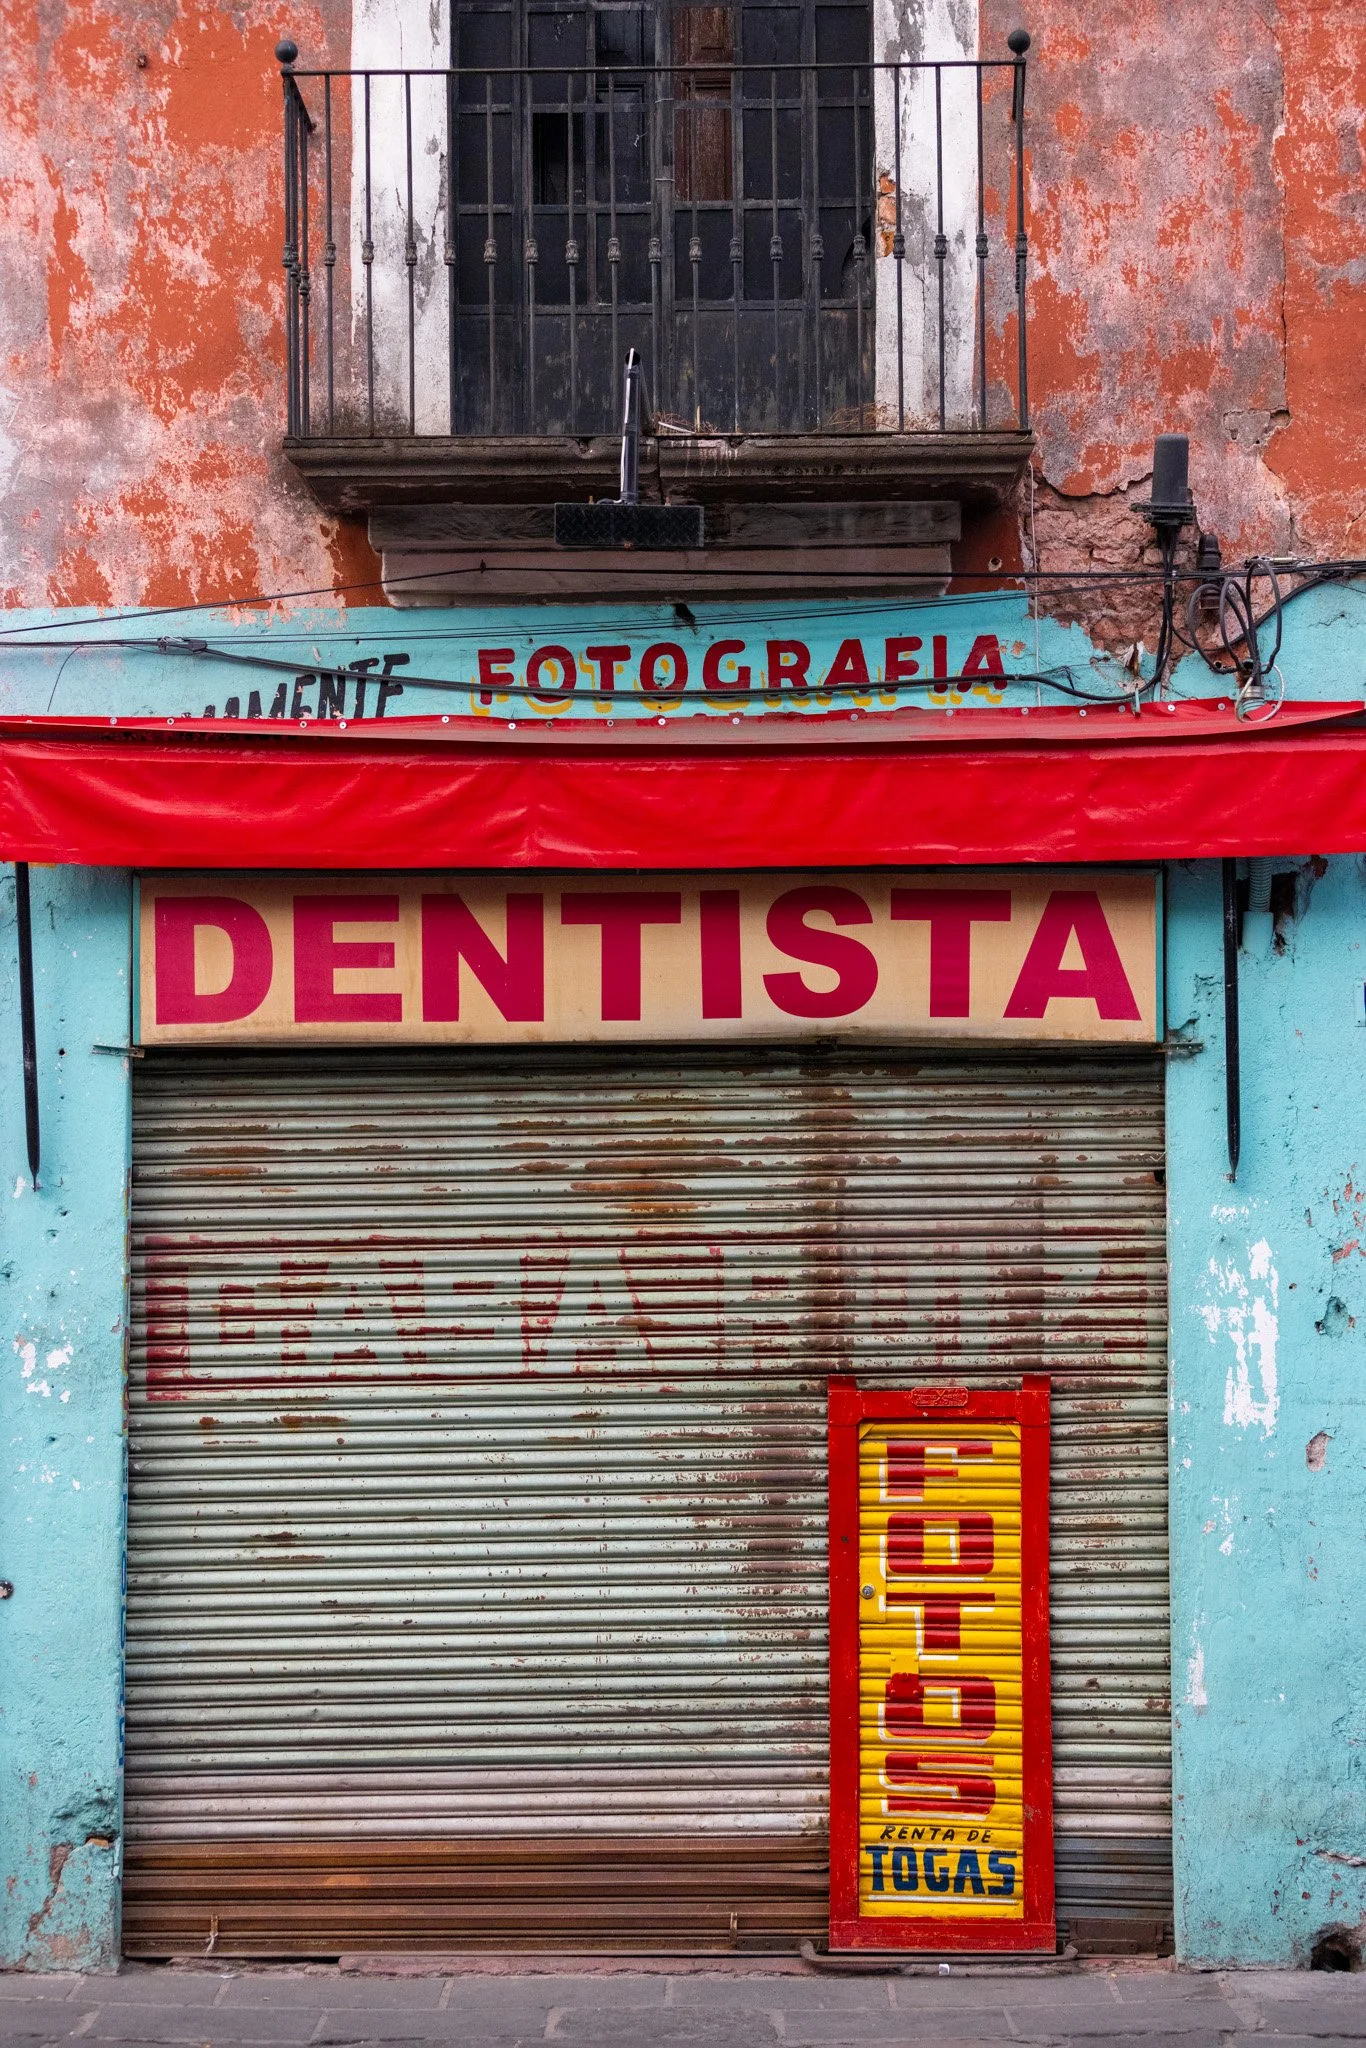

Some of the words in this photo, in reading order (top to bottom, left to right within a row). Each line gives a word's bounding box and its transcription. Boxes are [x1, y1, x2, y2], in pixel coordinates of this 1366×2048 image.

[474, 634, 1007, 711] FOTOGRAFIA
[154, 886, 1142, 1025] DENTISTA
[882, 1440, 996, 1817] FOTOS
[865, 1845, 1017, 1896] TOGAS
[880, 1825, 955, 1842] RENTA
[967, 1829, 994, 1843] DE
